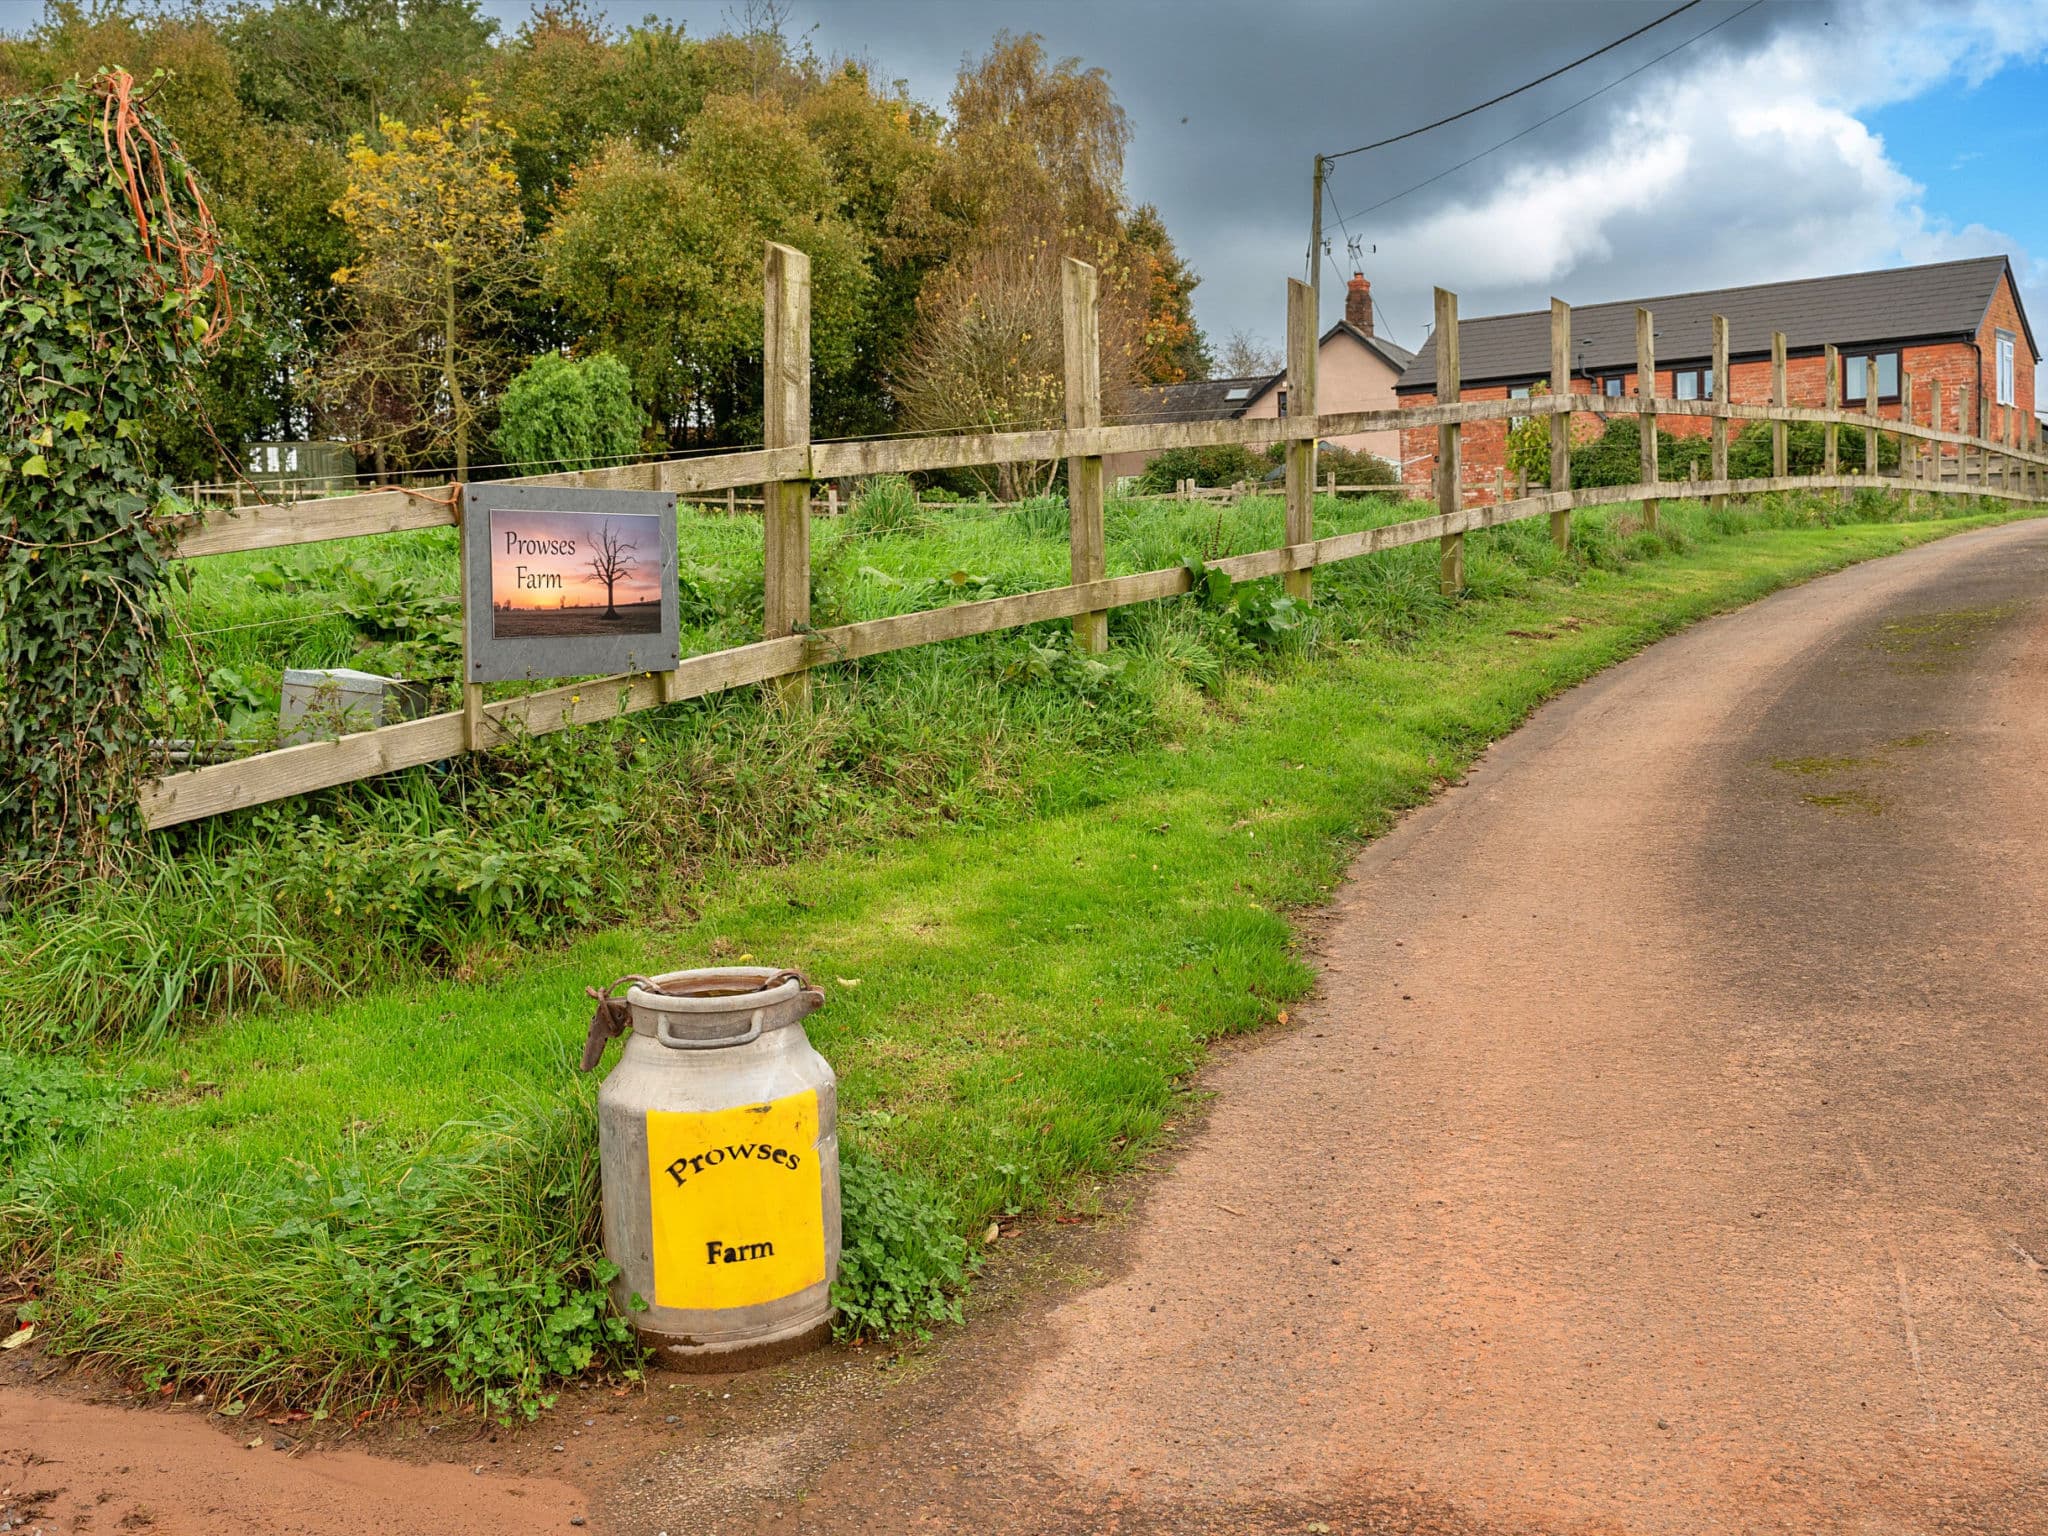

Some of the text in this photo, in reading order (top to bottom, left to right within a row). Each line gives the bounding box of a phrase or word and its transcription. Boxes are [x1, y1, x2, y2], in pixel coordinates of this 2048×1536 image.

[505, 531, 576, 555] Prowses
[516, 566, 562, 589] Farm
[666, 1143, 800, 1187] Prowses
[707, 1241, 774, 1264] Farm
